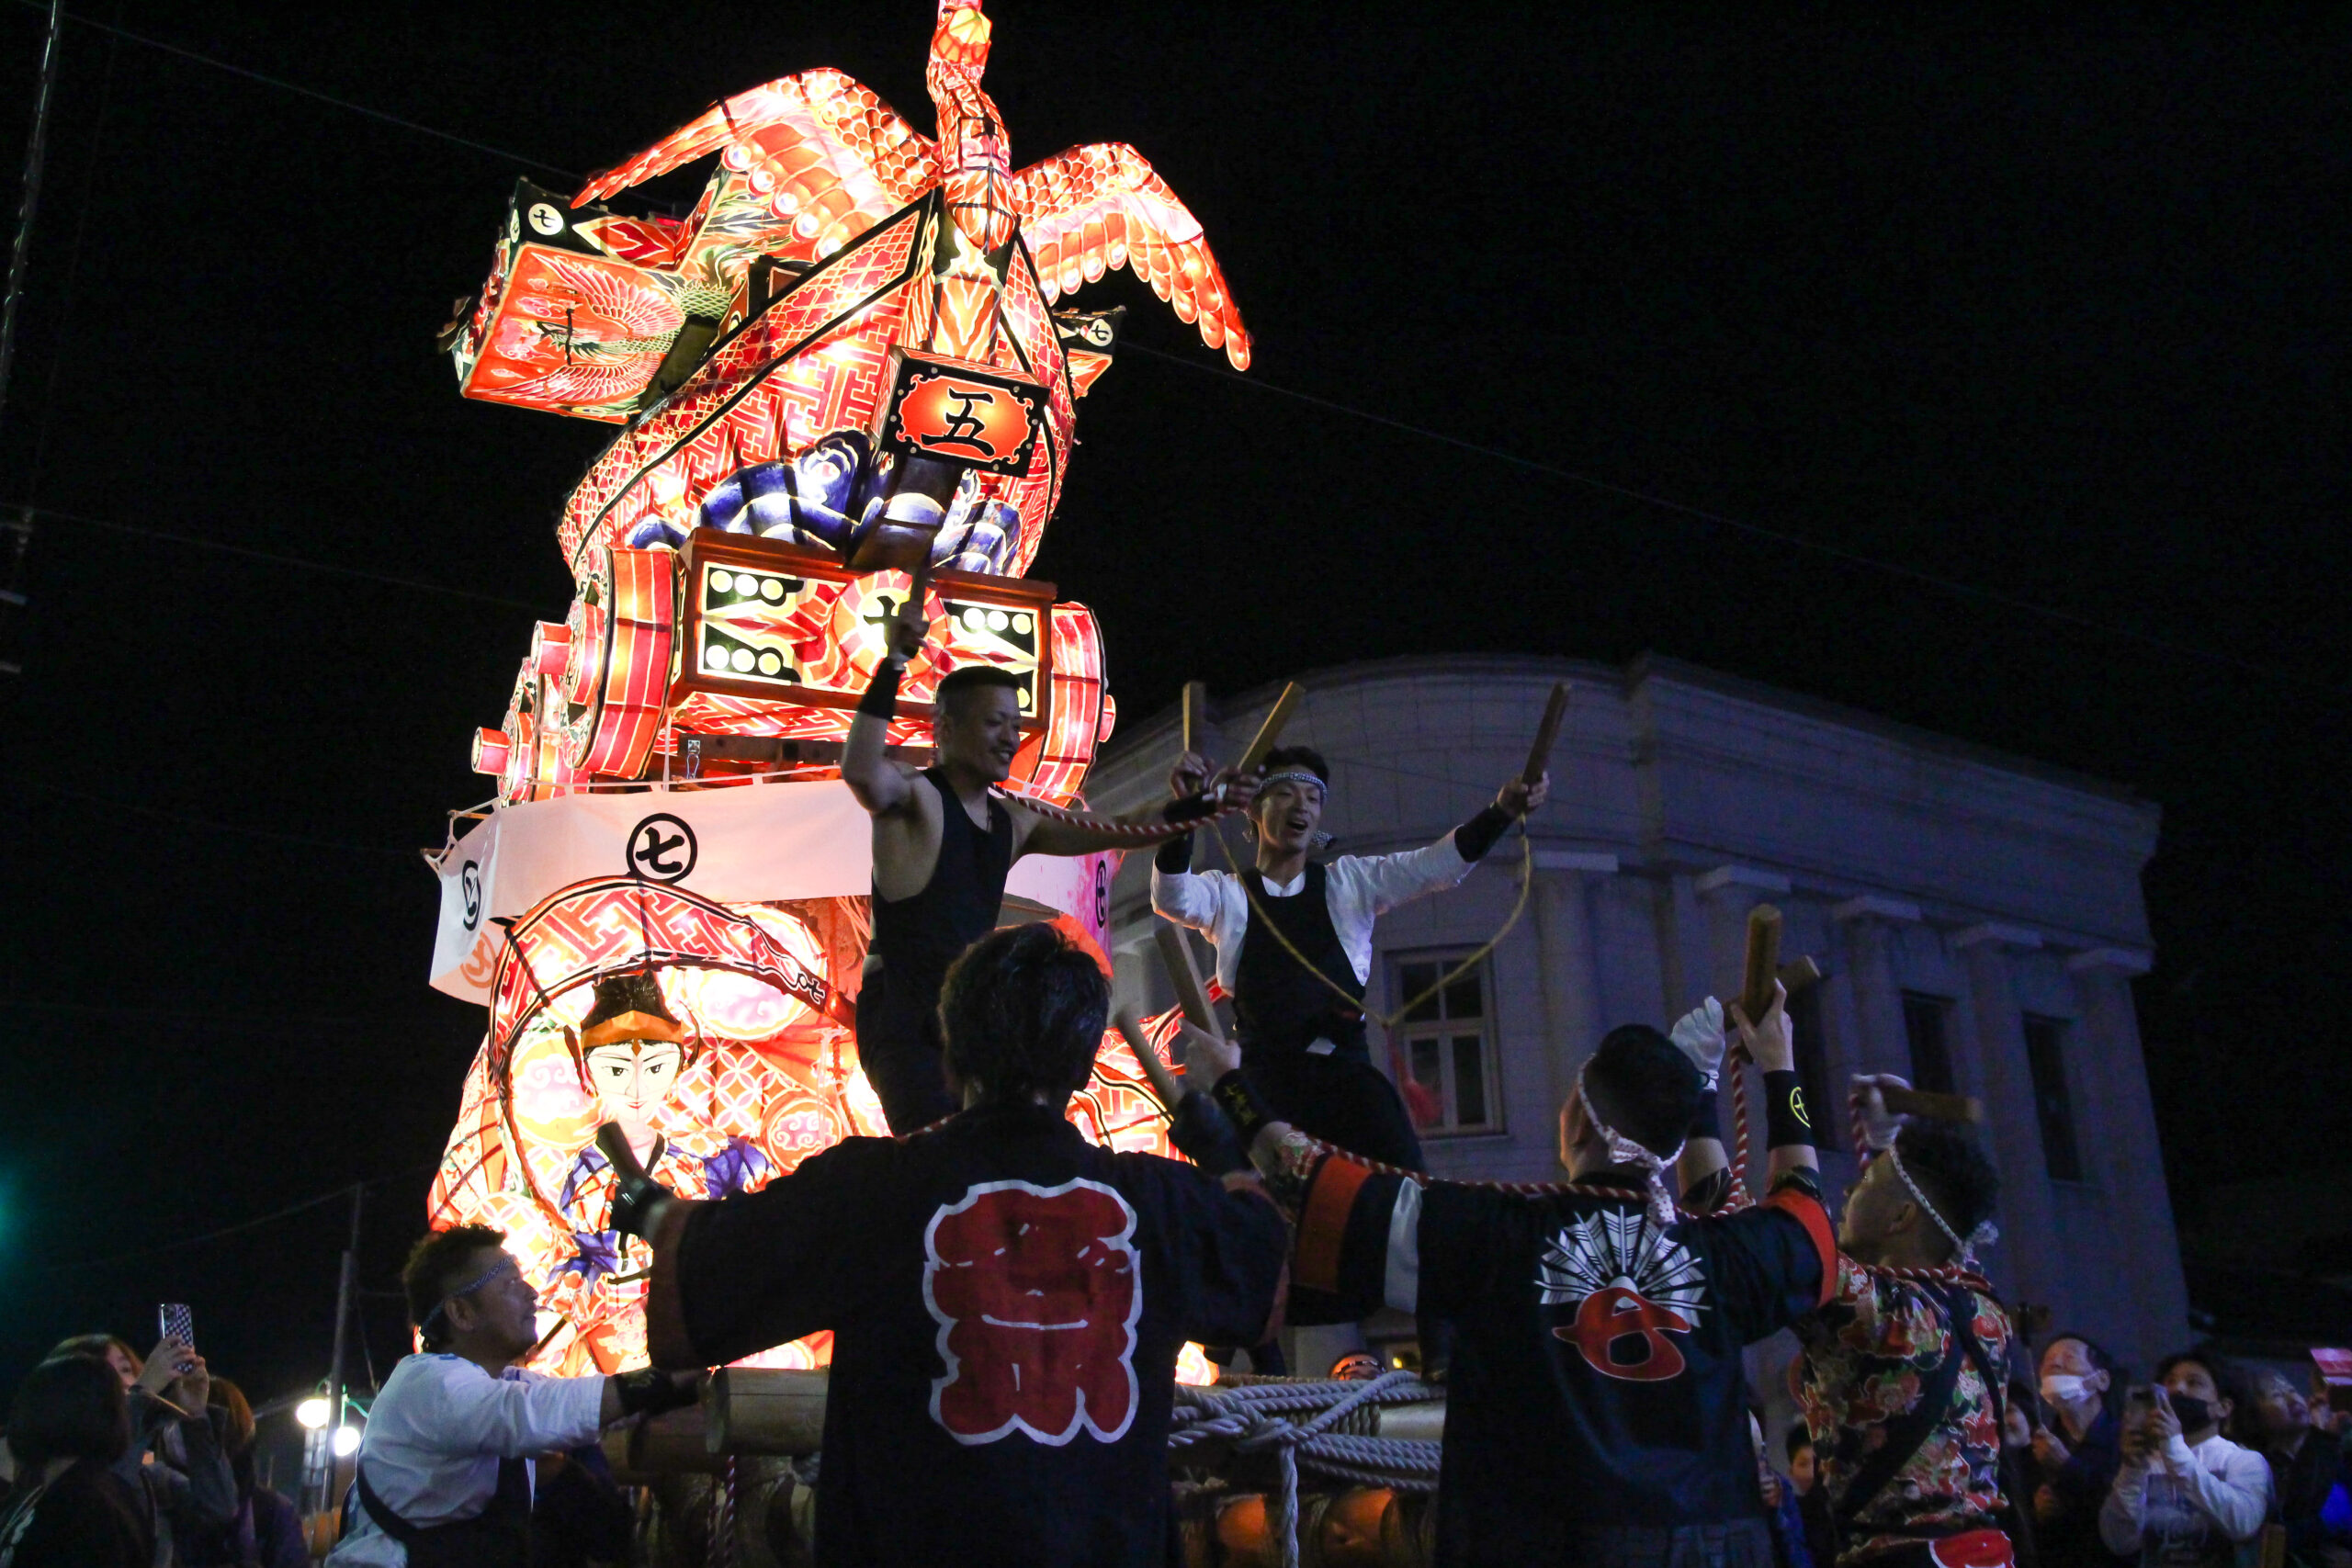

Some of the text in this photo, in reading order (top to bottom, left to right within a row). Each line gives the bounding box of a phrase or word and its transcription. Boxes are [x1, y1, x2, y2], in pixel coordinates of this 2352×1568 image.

[1091, 324, 1109, 342] 七
[921, 387, 995, 457] 五
[635, 826, 685, 874] 七
